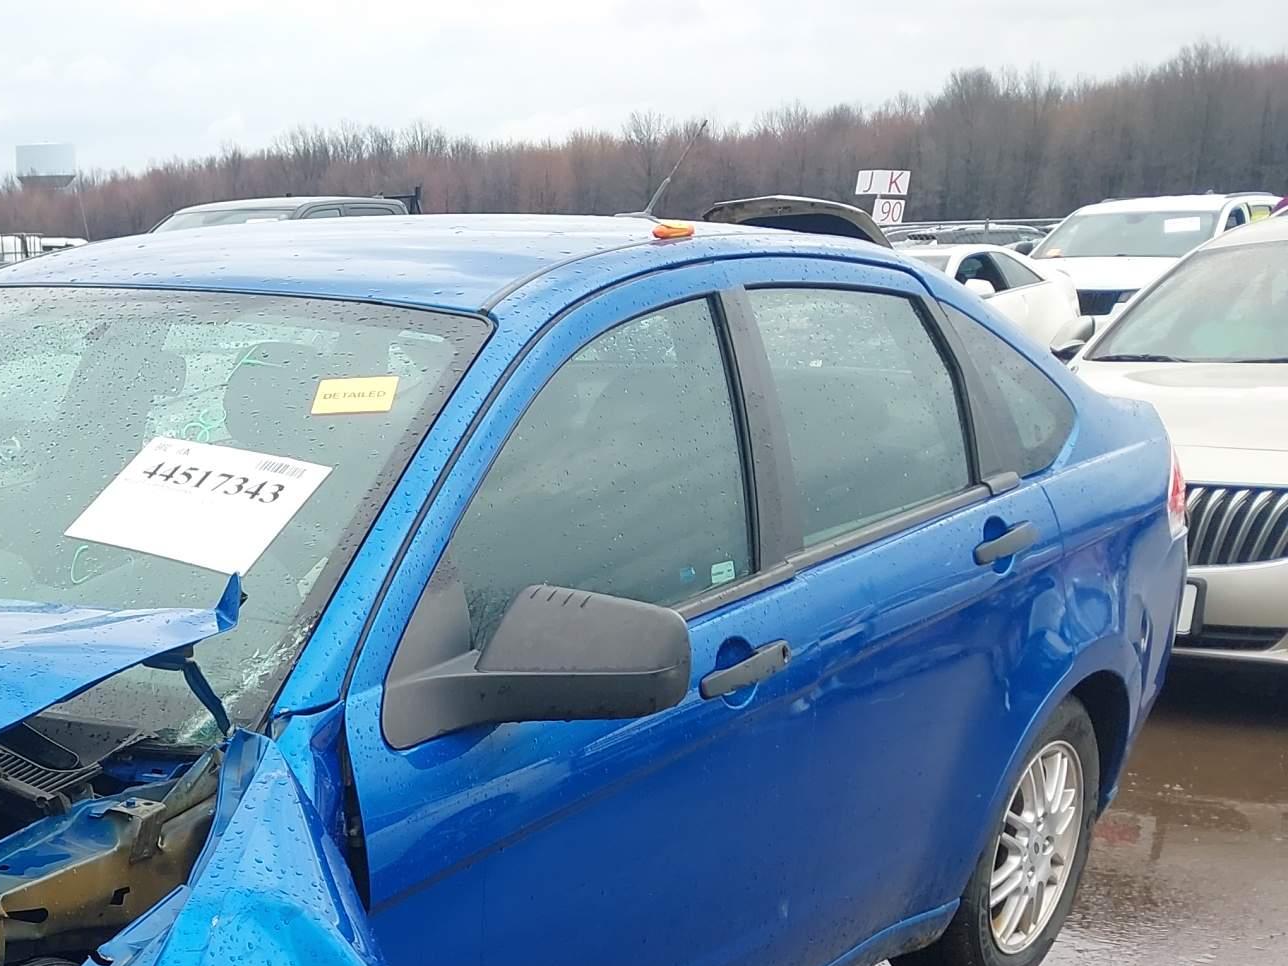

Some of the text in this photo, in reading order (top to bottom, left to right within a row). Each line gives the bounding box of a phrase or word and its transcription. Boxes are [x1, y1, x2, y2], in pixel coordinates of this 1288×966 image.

[863, 171, 905, 193] J K
[880, 201, 903, 222] 90
[322, 390, 387, 400] DETAILED
[142, 462, 285, 504] 44517343
